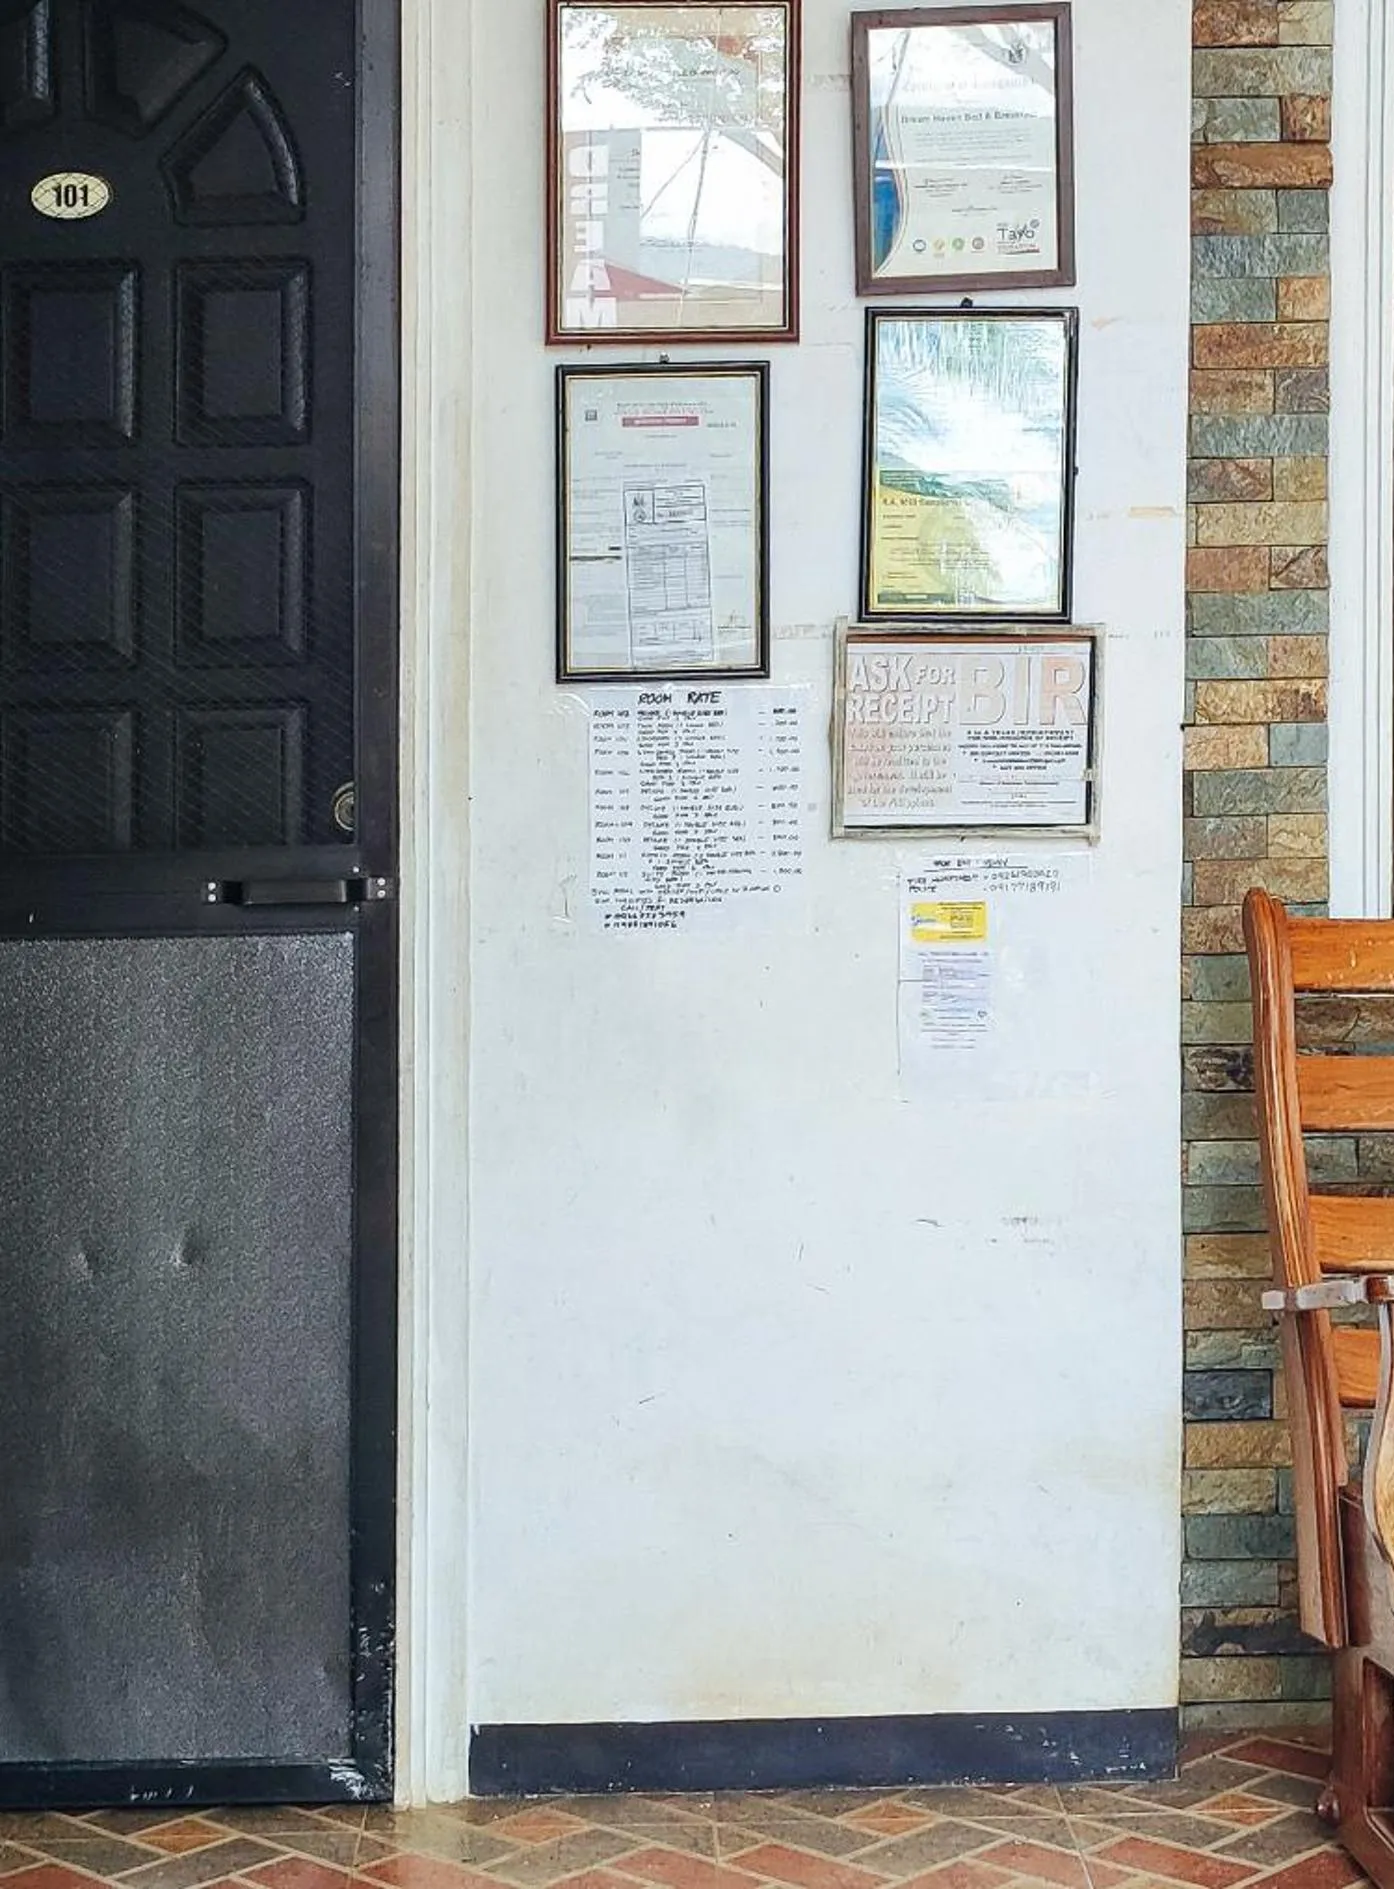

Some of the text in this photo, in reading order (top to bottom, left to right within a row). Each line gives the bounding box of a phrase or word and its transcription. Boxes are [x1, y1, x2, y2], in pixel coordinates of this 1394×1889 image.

[53, 183, 90, 208] 101
[848, 655, 956, 692] ASK FOR
[636, 691, 723, 705] ROOM RATE
[959, 655, 1088, 726] BIR
[846, 693, 957, 725] RECEIPT
